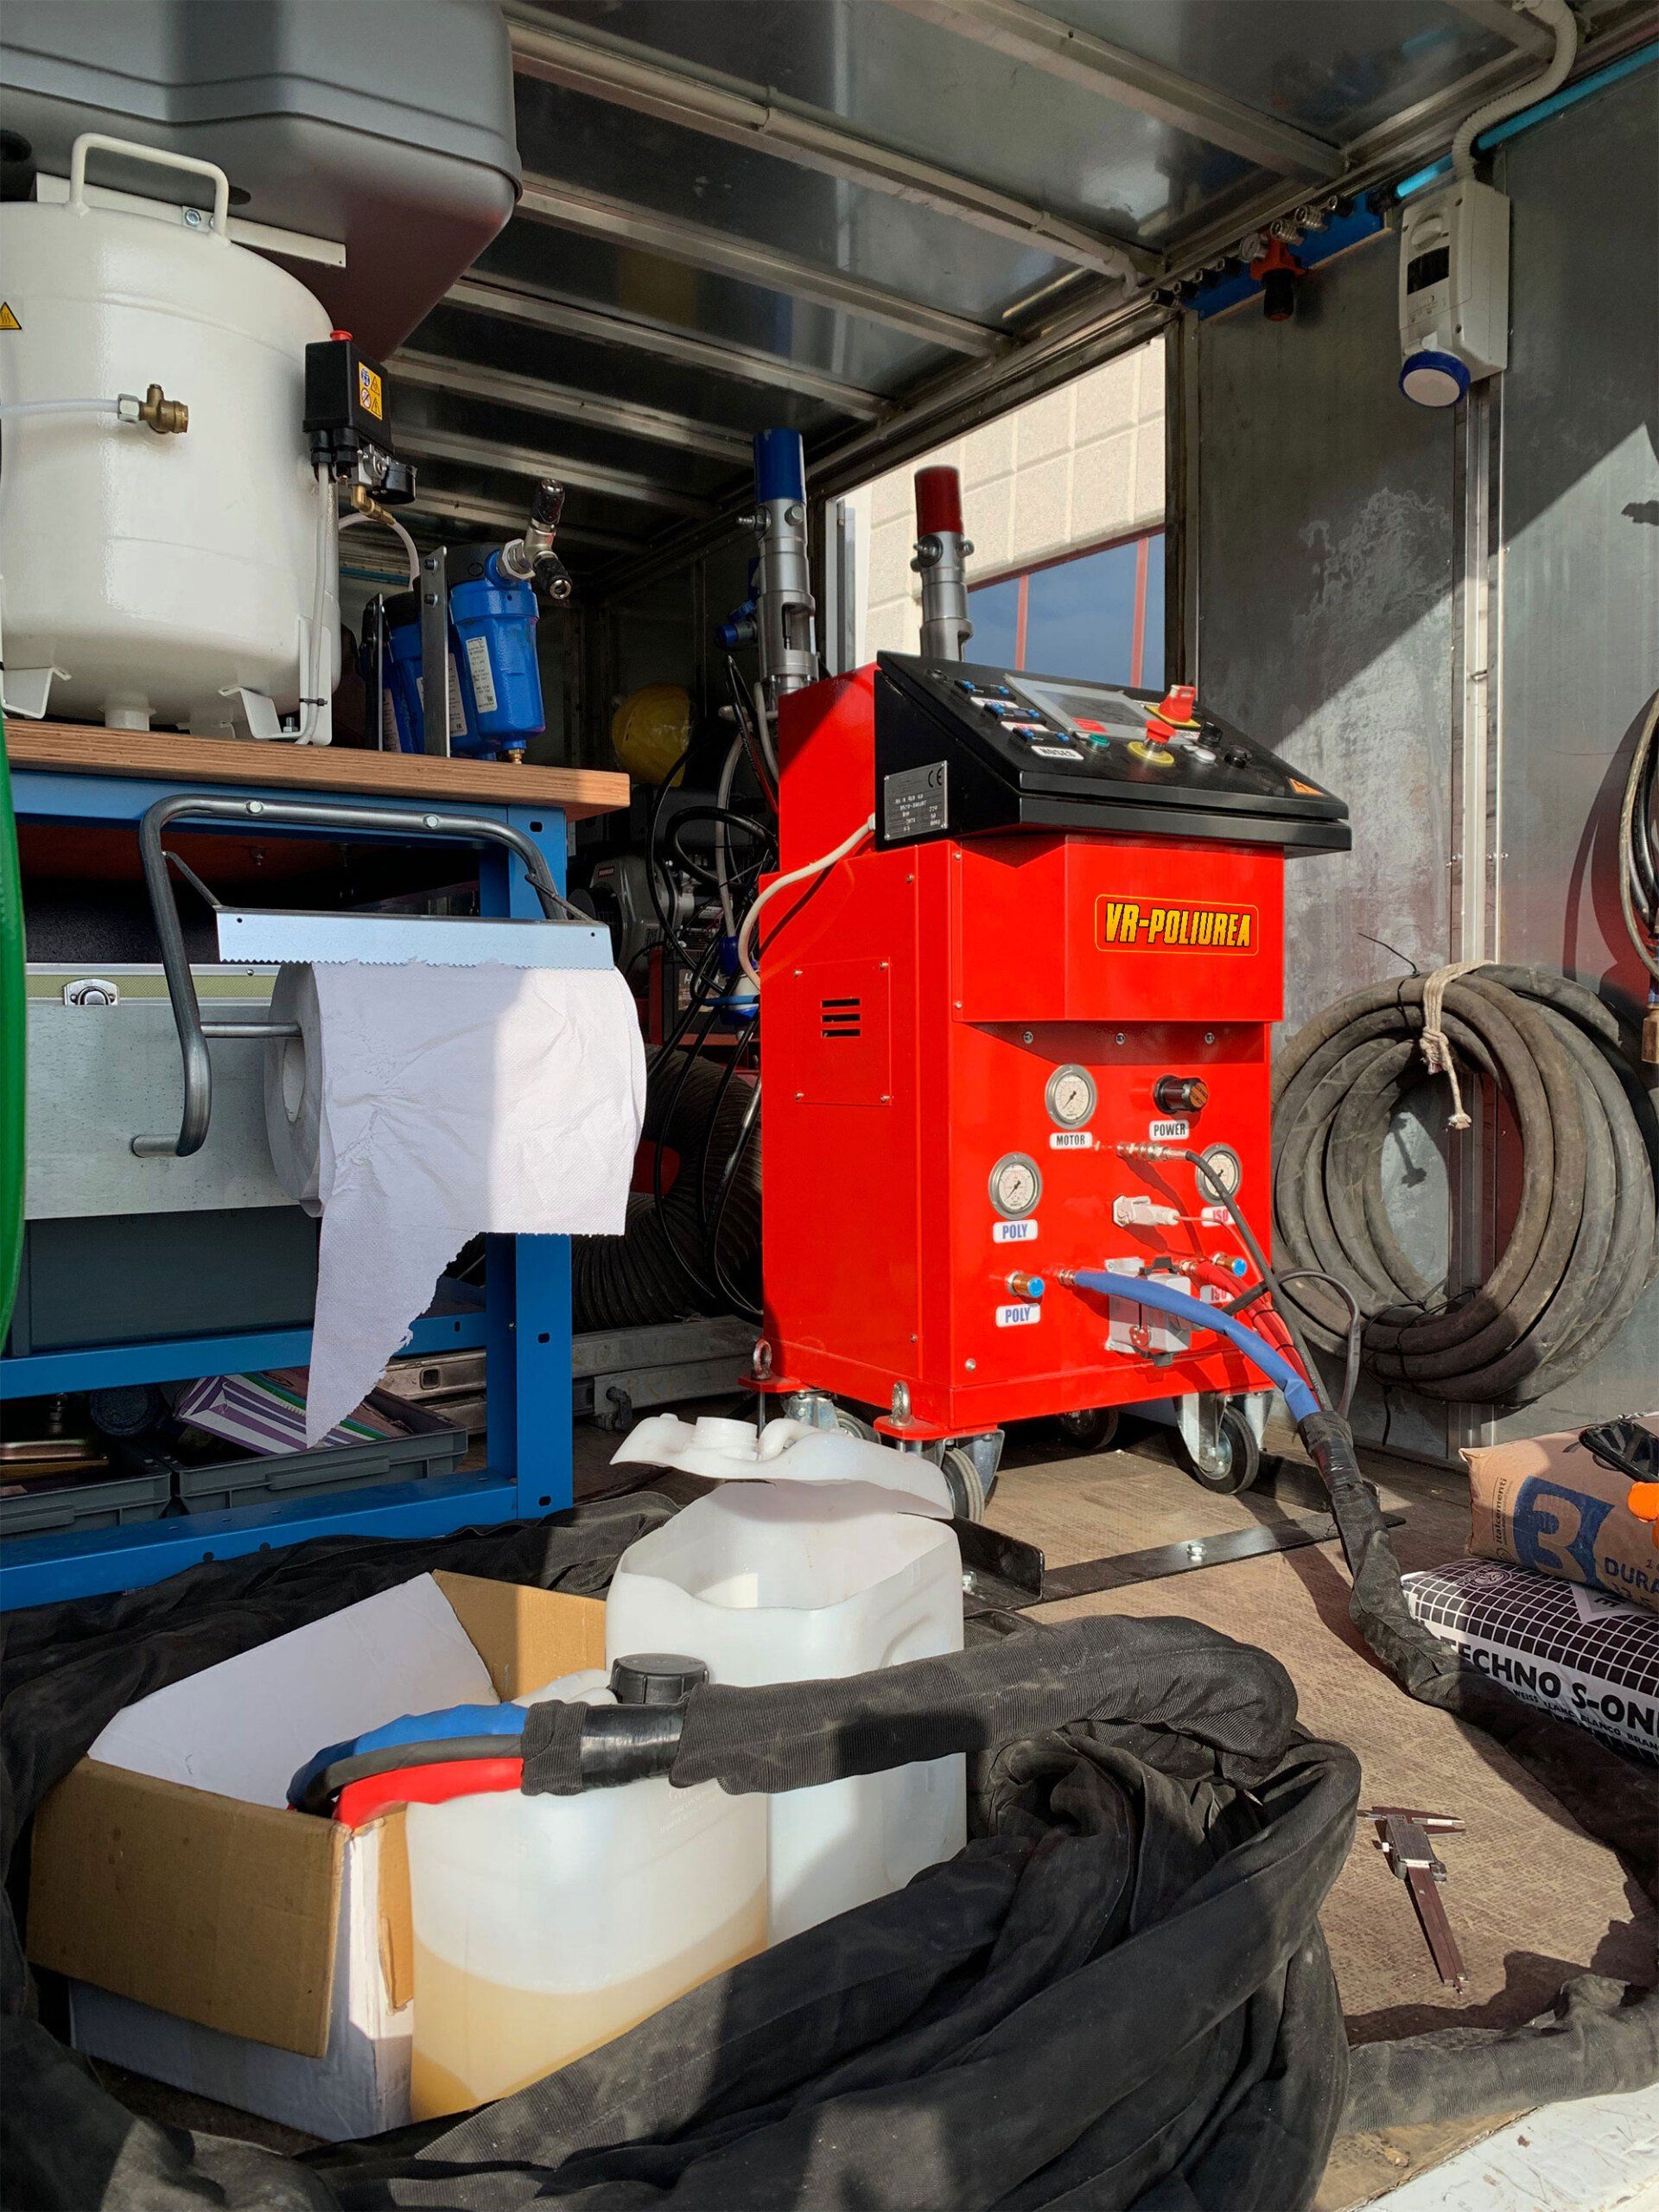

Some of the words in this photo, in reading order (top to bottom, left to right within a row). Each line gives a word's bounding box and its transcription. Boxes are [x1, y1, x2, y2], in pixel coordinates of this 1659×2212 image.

[1105, 902, 1251, 947] VR-POLIUREA
[1154, 1123, 1186, 1136] POWER
[1056, 1135, 1085, 1146] MOTOR
[1212, 1210, 1229, 1222] ISO
[1002, 1224, 1028, 1239] POLY
[1005, 1306, 1030, 1323] POLY
[1495, 1477, 1508, 1544] Italcementi
[1572, 1682, 1659, 1737] S-ON
[1513, 1688, 1539, 1703] WEISS
[1580, 1714, 1622, 1736] BLANCO
[1626, 1732, 1659, 1752] BRAN
